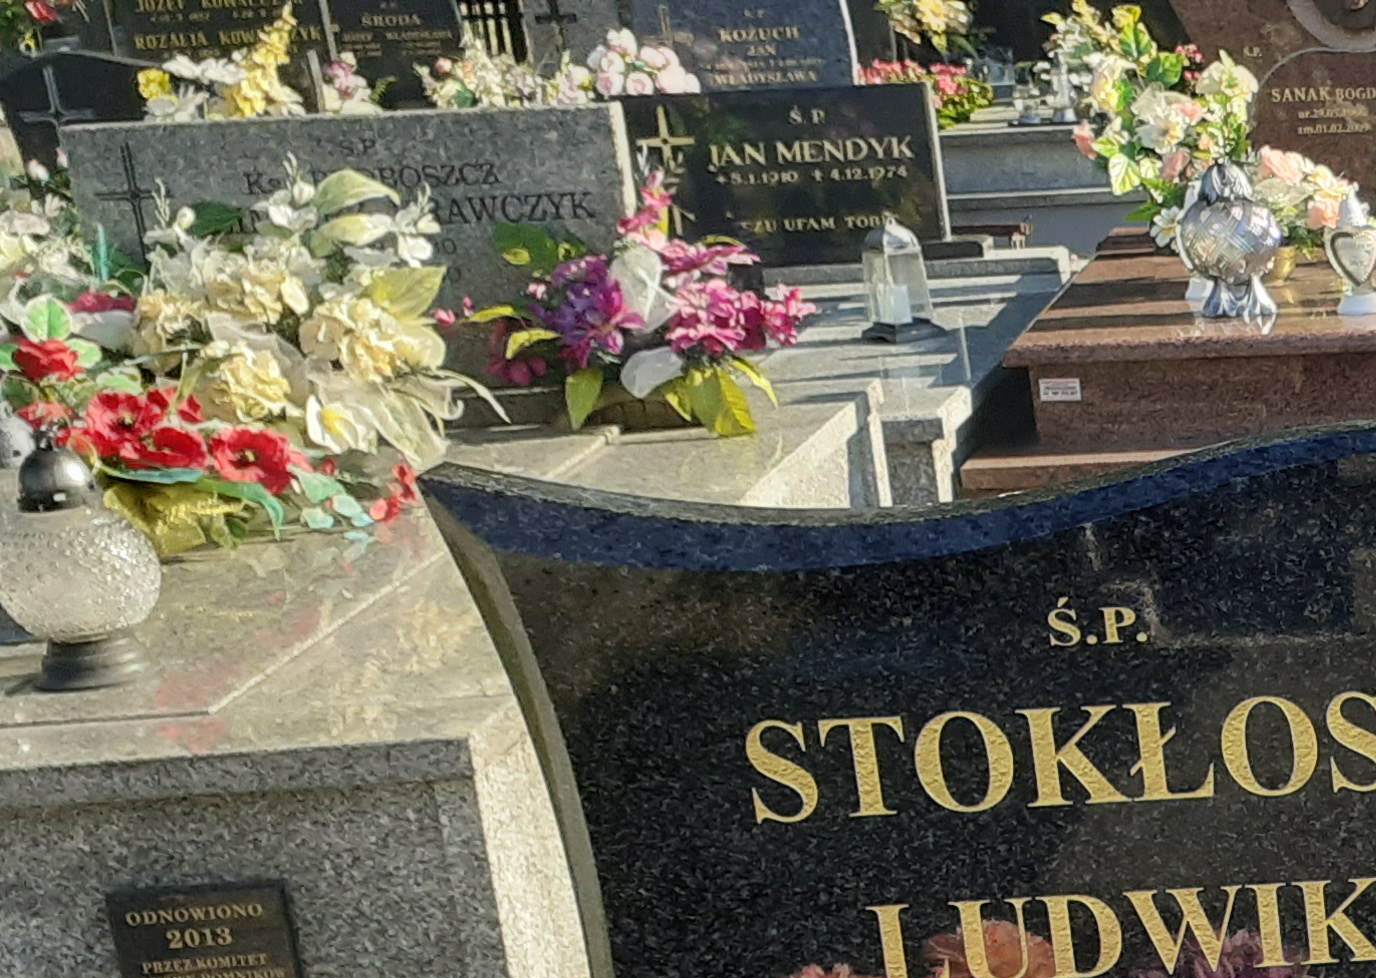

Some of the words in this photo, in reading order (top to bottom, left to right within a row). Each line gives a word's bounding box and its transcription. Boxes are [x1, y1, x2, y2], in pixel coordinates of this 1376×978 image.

[1271, 87, 1331, 102] SANAK
[706, 141, 766, 173] JAN
[775, 135, 916, 165] MENDYK
[784, 216, 837, 231] UFAM
[1048, 596, 1149, 648] Ś.P.
[125, 903, 264, 927] ODNOWIONO
[166, 926, 233, 949] 2013
[141, 957, 196, 975] PRZEZ
[197, 953, 268, 971] KOMITET
